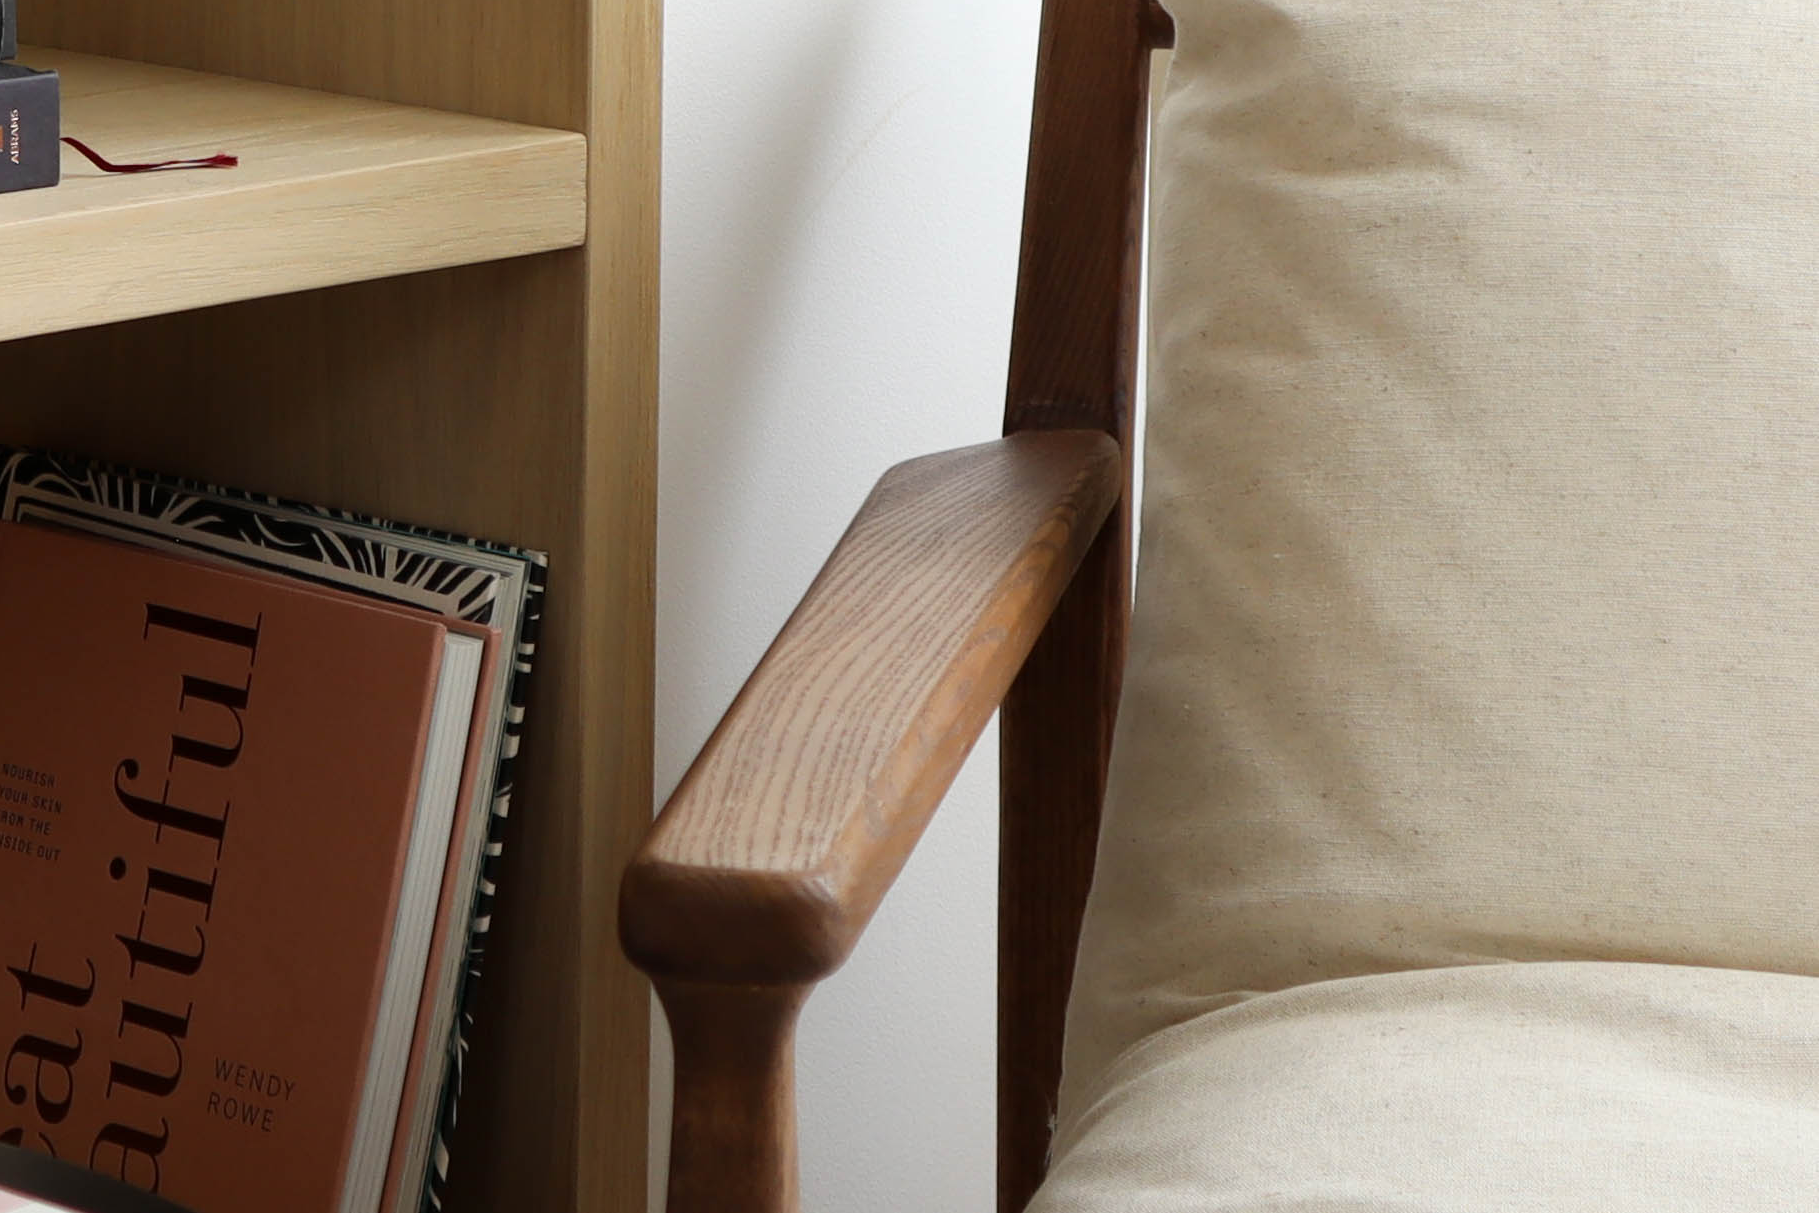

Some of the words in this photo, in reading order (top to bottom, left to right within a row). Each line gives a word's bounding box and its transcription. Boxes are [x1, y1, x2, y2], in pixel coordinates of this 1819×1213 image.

[10, 108, 19, 164] ABRAMS
[1, 763, 56, 789] NOURISH
[31, 795, 63, 815] SKIN
[29, 817, 52, 836] THE
[37, 844, 62, 861] OUT
[88, 602, 263, 1196] autiful
[214, 1055, 296, 1101] WENDY
[207, 1091, 275, 1133] ROWE
